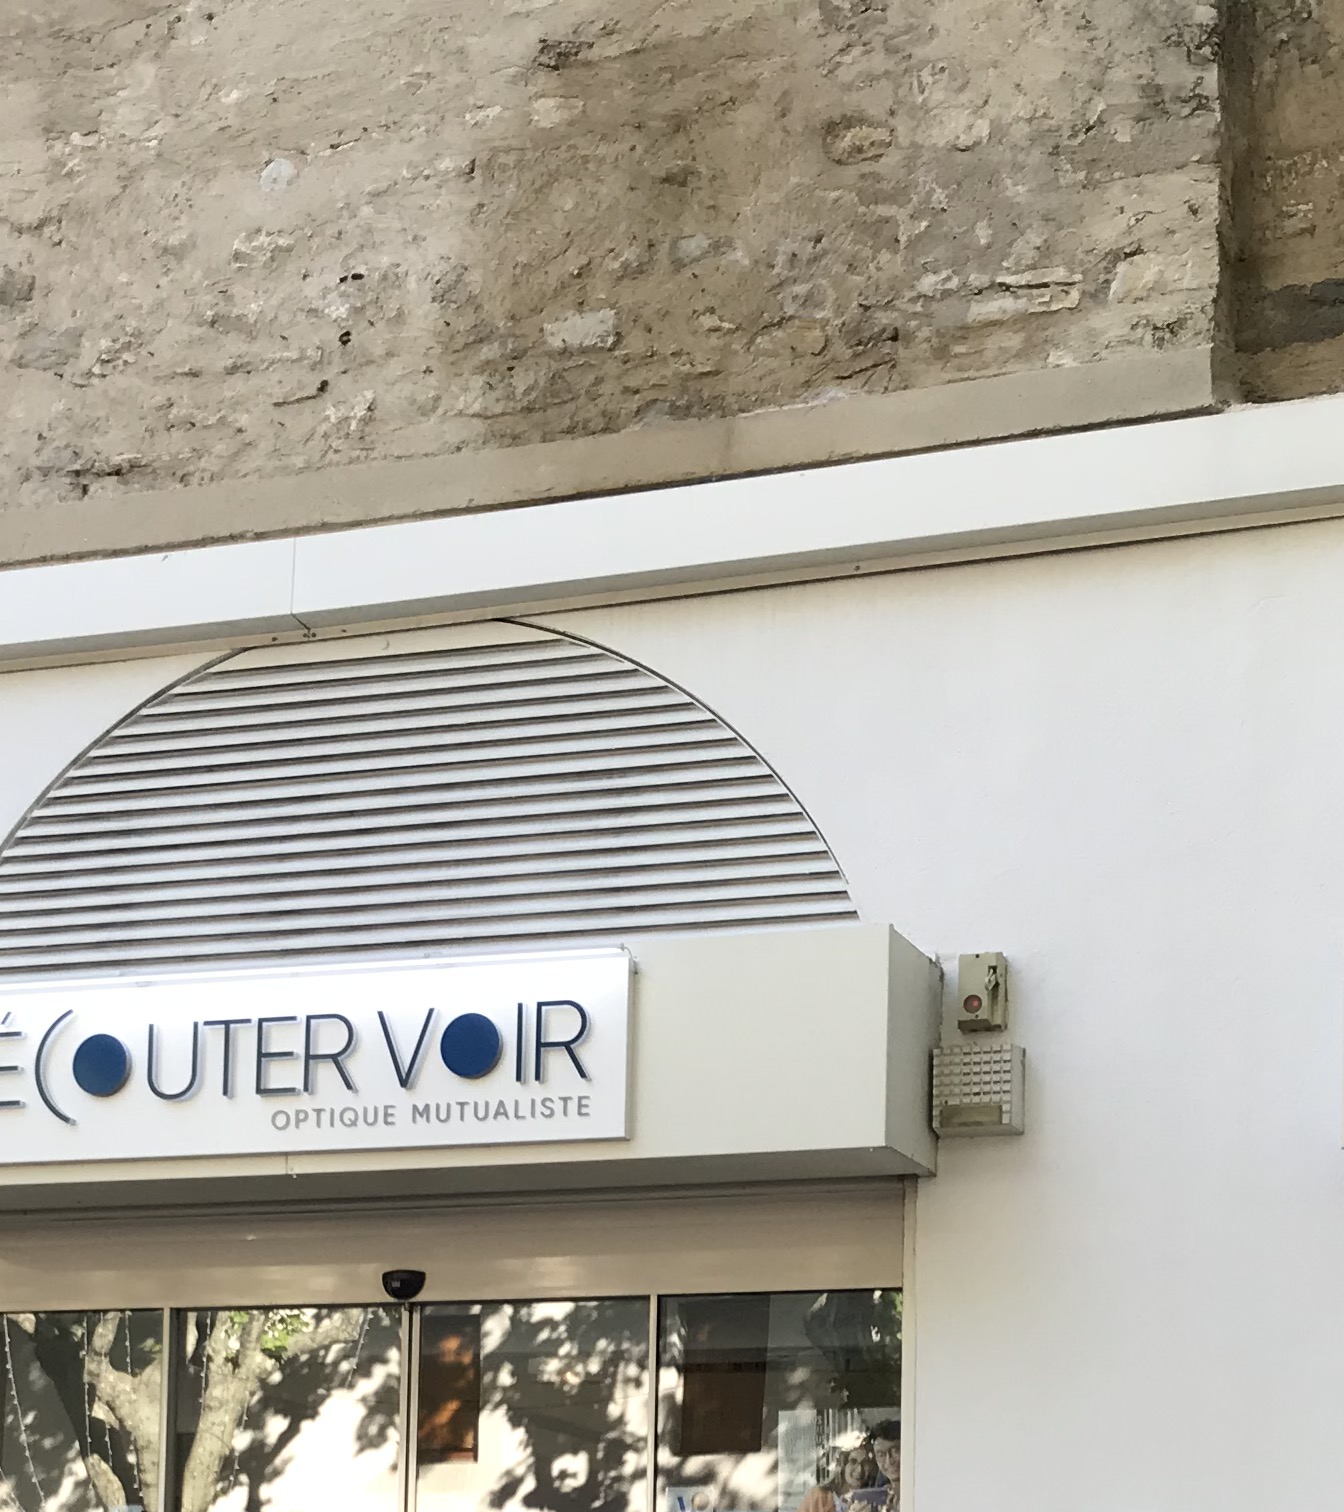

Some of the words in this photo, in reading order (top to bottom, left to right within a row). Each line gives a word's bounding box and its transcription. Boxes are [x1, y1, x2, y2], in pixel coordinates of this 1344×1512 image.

[377, 1000, 592, 1089] VOIR
[271, 1104, 397, 1131] OPTIQUE
[411, 1095, 592, 1125] MUTUALISTE
